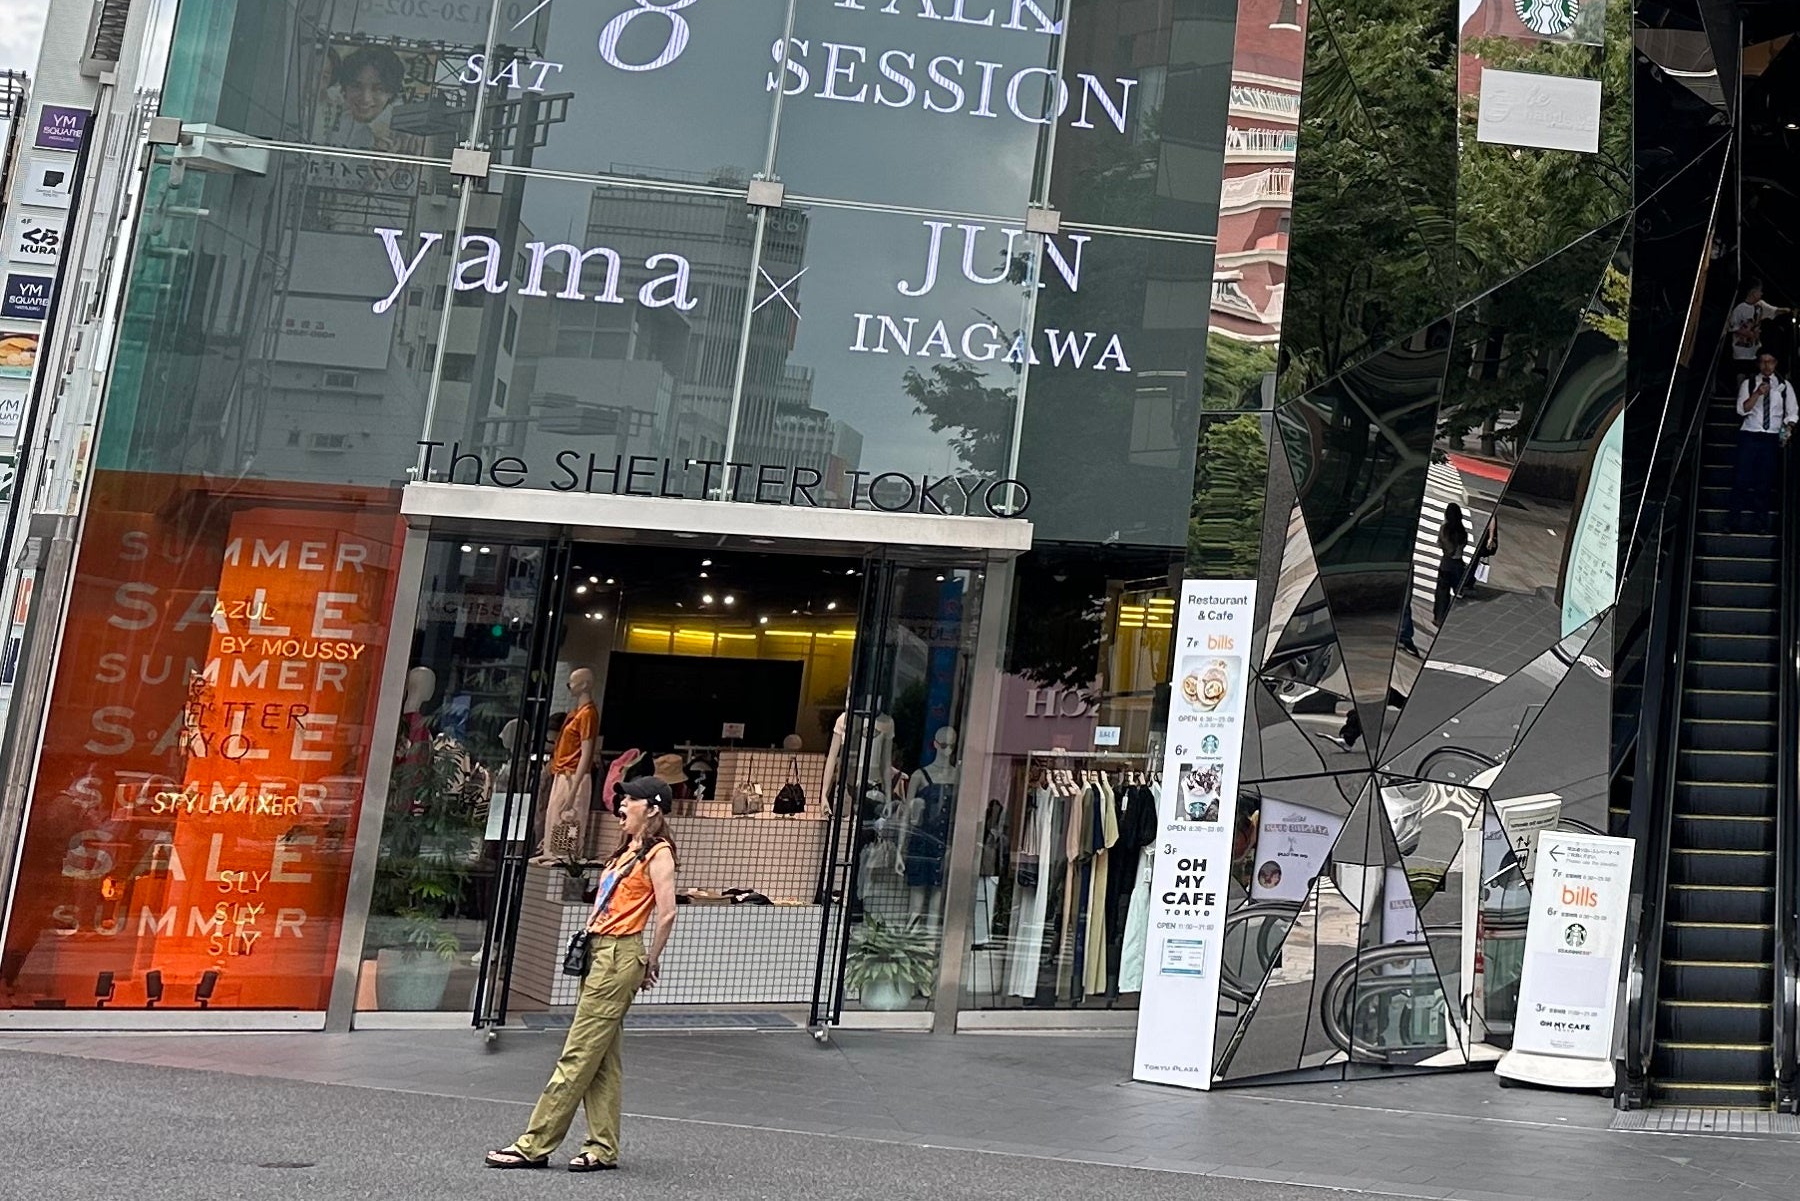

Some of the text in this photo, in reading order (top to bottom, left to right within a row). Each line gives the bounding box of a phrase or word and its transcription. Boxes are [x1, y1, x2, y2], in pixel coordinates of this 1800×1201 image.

[460, 53, 563, 93] SAT
[766, 37, 1138, 135] SESSION
[54, 114, 76, 128] YM
[20, 244, 57, 255] KURA
[372, 225, 698, 314] yama
[897, 219, 1092, 297] JUN
[20, 283, 43, 296] YM
[849, 312, 1132, 373] INAGAWA
[416, 440, 528, 489] The
[849, 470, 1032, 519] TOKYO
[119, 529, 369, 575] SUMMER
[107, 580, 362, 639] SALE
[211, 597, 276, 621] AZUL
[1188, 595, 1248, 606] Restaurant
[1198, 611, 1234, 621] & Cafe
[220, 636, 366, 661] BY MOUSSY
[1207, 634, 1234, 650] bills
[95, 653, 349, 693] SUMMER
[1178, 715, 1197, 723] OPEN
[84, 704, 339, 762] SALE
[75, 775, 329, 815] SUMMER
[150, 791, 299, 816] STYLEMIXER
[62, 828, 314, 883] SALE
[1177, 858, 1207, 872] OH
[217, 870, 270, 894] SLY
[1175, 875, 1205, 889] MY
[1162, 892, 1216, 906] CAFE
[1562, 884, 1598, 907] bills
[50, 903, 308, 939] SUMMER
[213, 901, 264, 926] SLY
[1165, 908, 1210, 917] TOKYO
[207, 931, 260, 956] SLY
[1568, 1022, 1591, 1031] CAFE
